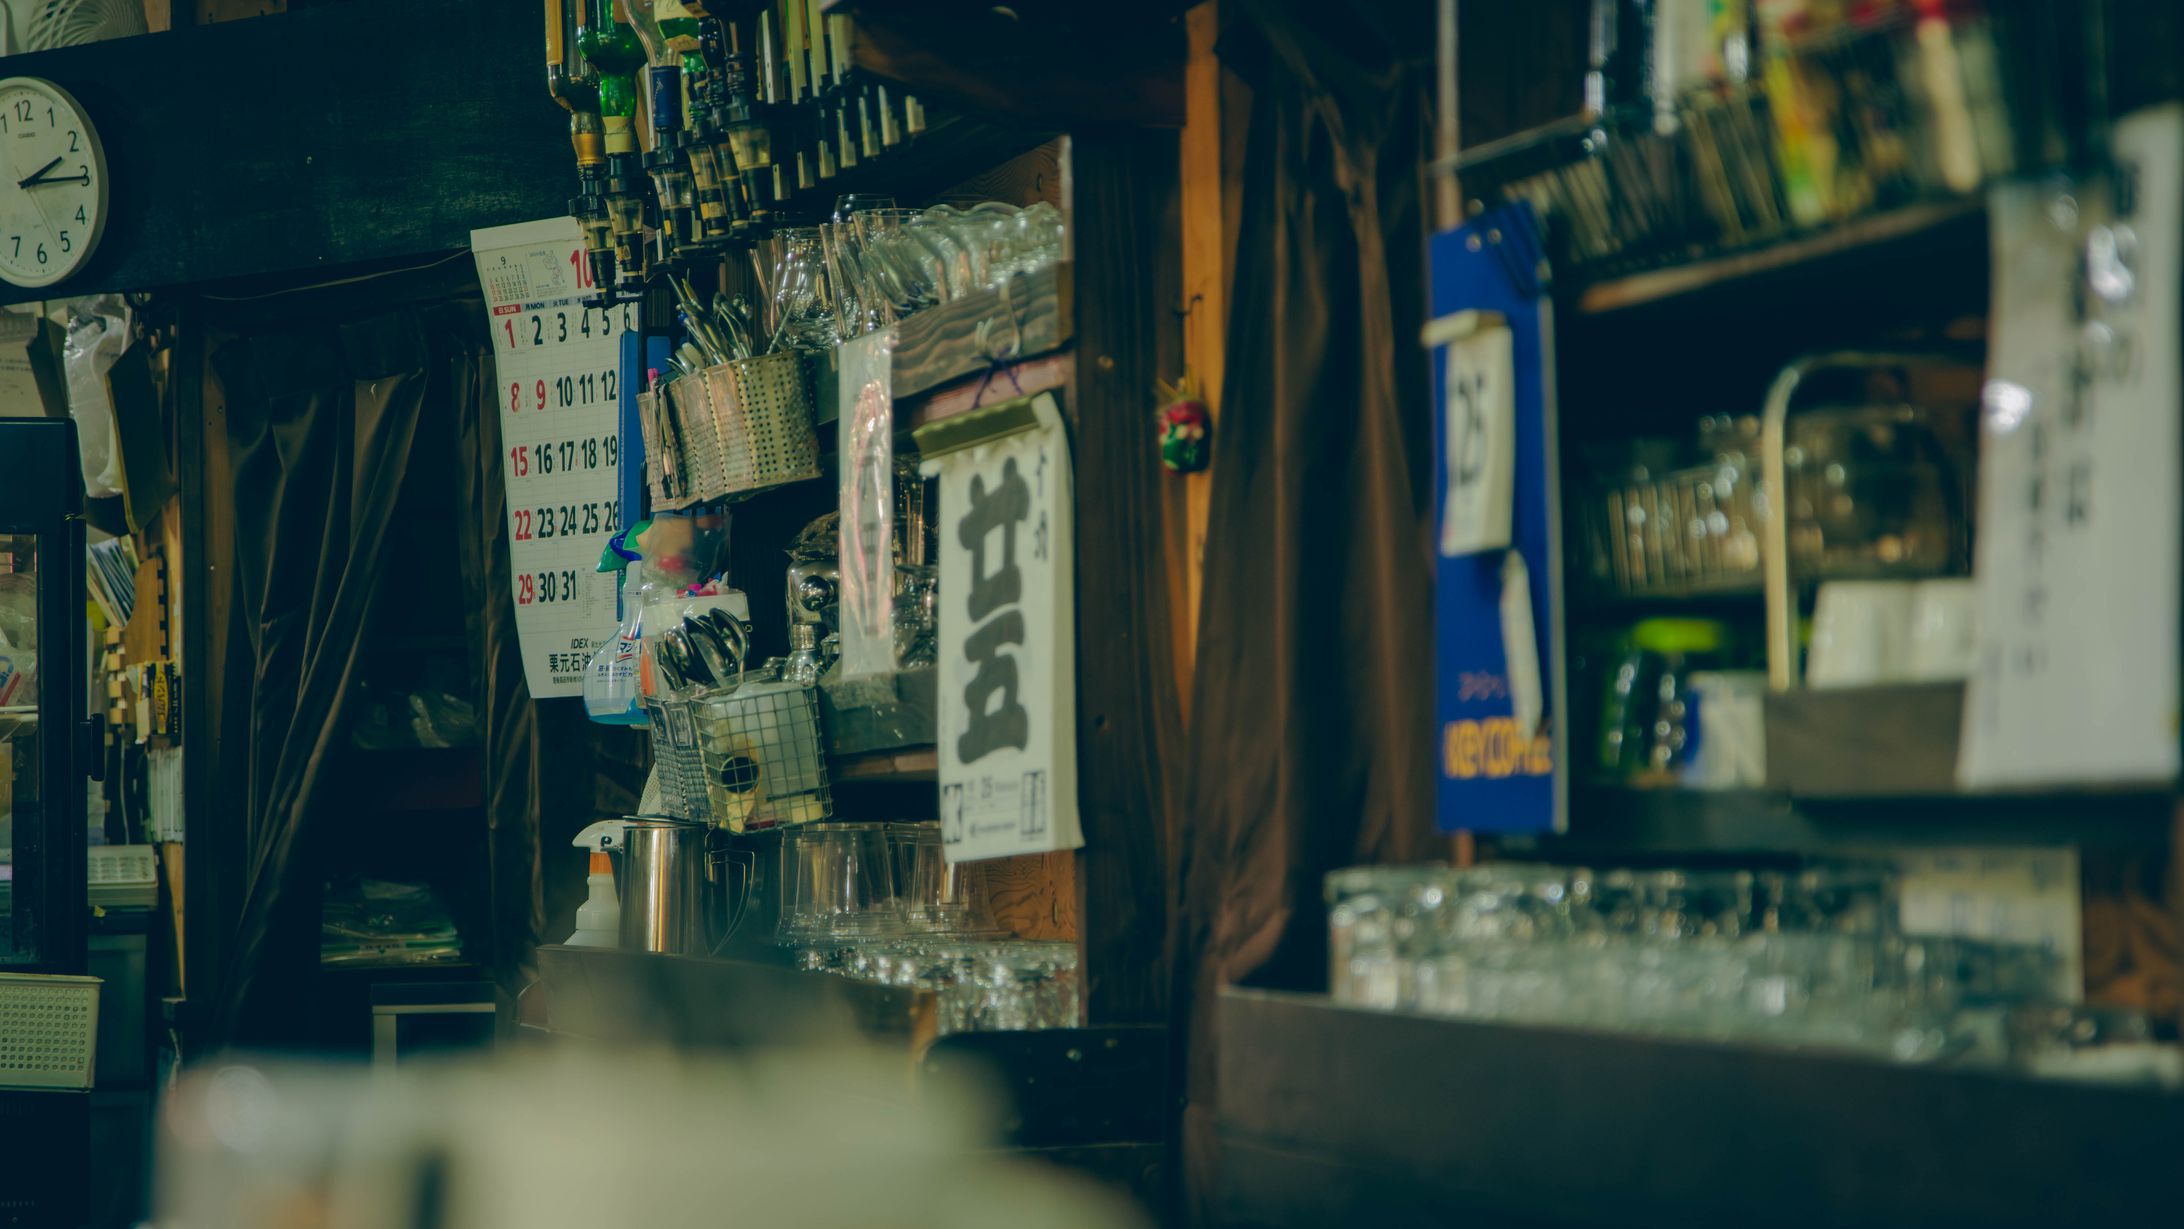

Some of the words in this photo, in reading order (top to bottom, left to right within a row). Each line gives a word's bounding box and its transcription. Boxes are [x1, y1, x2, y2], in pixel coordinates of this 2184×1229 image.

[14, 99, 34, 122] 12
[46, 106, 55, 128] 1
[67, 130, 79, 152] 2
[79, 165, 90, 187] 3
[75, 204, 86, 225] 4
[11, 236, 21, 257] 7
[60, 230, 71, 252] 5
[37, 243, 48, 264] 6
[500, 256, 507, 265] 9
[570, 247, 593, 289] 10
[504, 319, 515, 348] 1
[531, 315, 544, 345] 2
[557, 312, 567, 342] 3
[581, 309, 590, 338] 4
[602, 308, 610, 335] 5
[623, 303, 631, 330] 6
[511, 382, 520, 412] 8
[535, 379, 546, 410] 9
[556, 376, 573, 407] 10
[579, 373, 594, 404] 11
[601, 369, 617, 401] 12
[511, 446, 529, 477] 15
[535, 443, 553, 474] 16
[559, 440, 575, 471] 17
[581, 438, 597, 469] 18
[603, 435, 618, 467] 19
[514, 509, 532, 541] 22
[537, 507, 555, 538] 23
[560, 505, 577, 536] 24
[582, 503, 599, 534] 25
[518, 574, 533, 605] 29
[538, 571, 556, 603] 30
[561, 570, 577, 601] 31
[570, 638, 589, 649] IDEX
[548, 651, 597, 673] 栗元石油
